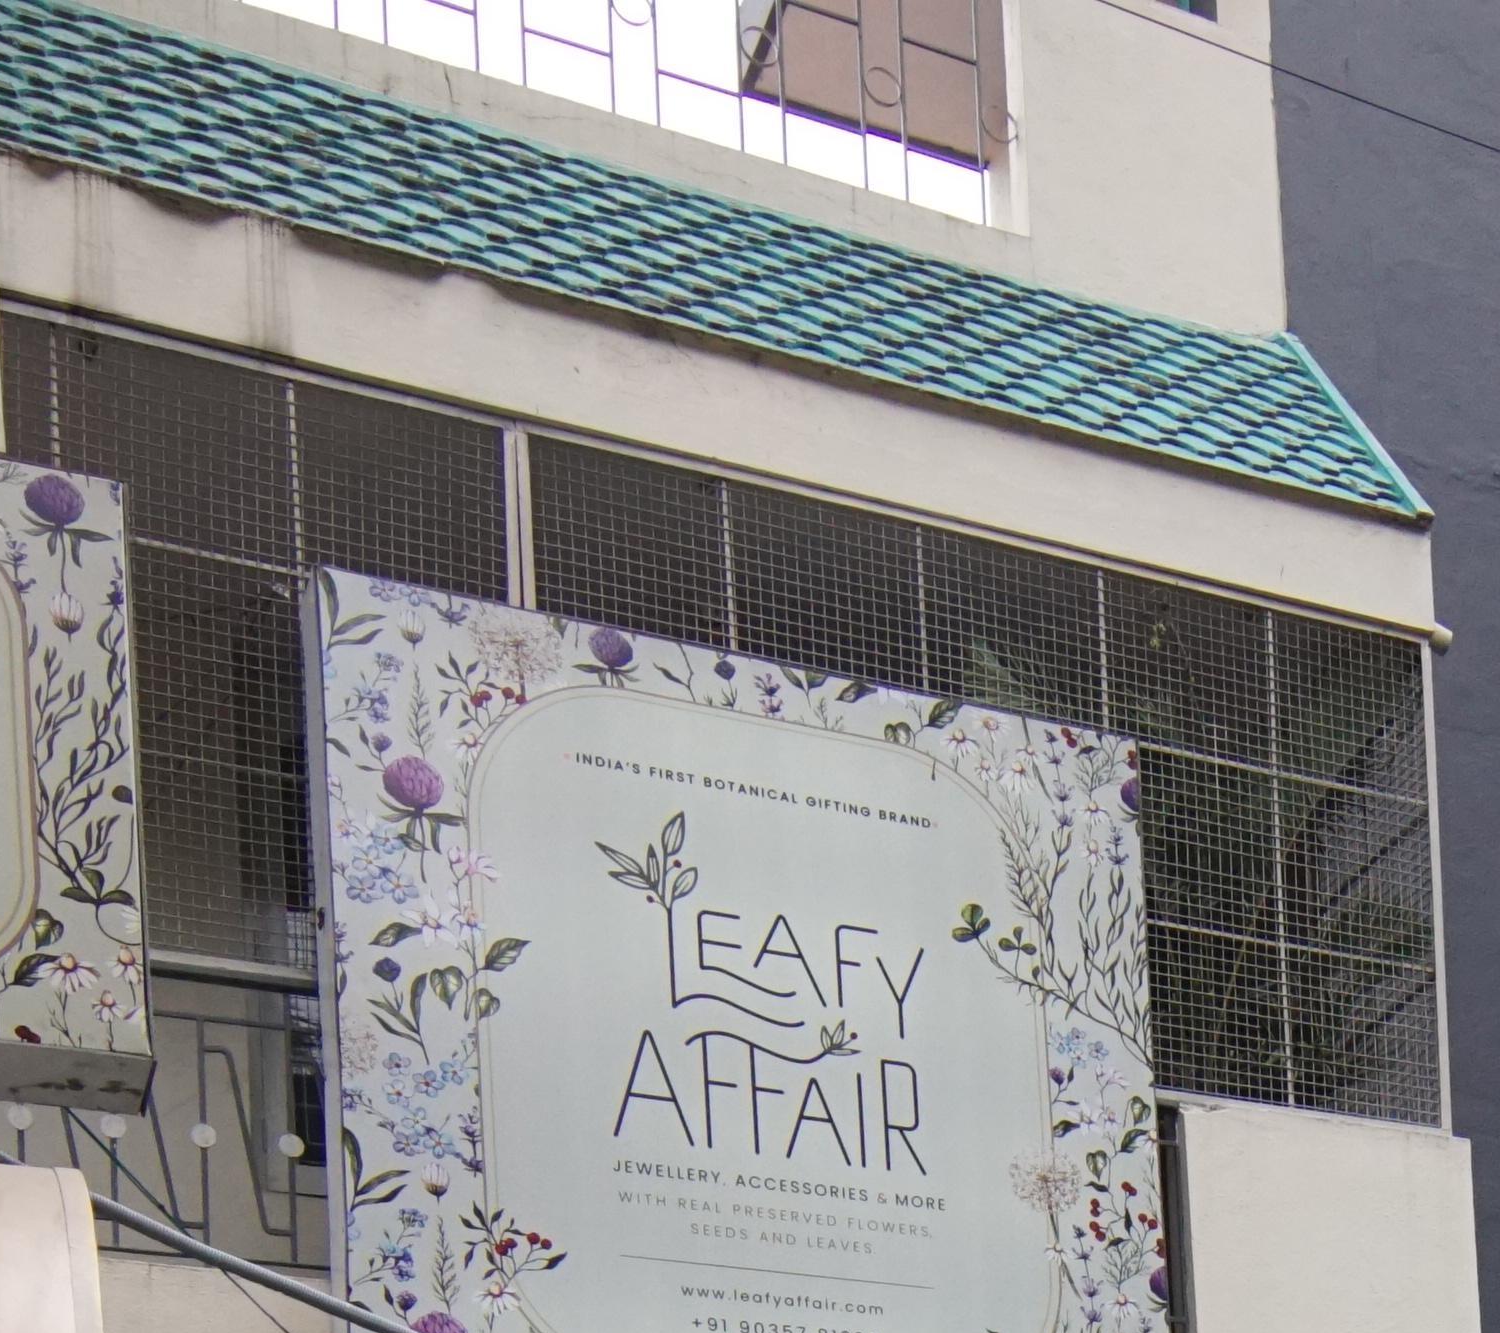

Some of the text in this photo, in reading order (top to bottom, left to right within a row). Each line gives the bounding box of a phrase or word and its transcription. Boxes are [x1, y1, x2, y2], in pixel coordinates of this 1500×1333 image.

[575, 751, 932, 829] INDIA'S FIRST BOTANICAL GIFTING BRAND
[667, 895, 926, 1040] LEAFY
[613, 1029, 928, 1176] AFFAIR
[618, 1190, 668, 1207] WITH
[677, 1197, 722, 1214] REAL
[732, 1203, 838, 1228] PRESERVED
[735, 1174, 869, 1203] ACCESSORIES
[876, 1192, 888, 1205] &
[895, 1193, 947, 1212] MORE
[690, 1222, 749, 1240] SEEDS
[759, 1231, 797, 1246] AND
[680, 1285, 885, 1317] www.leafyaffair.com
[691, 1316, 729, 1333] +91
